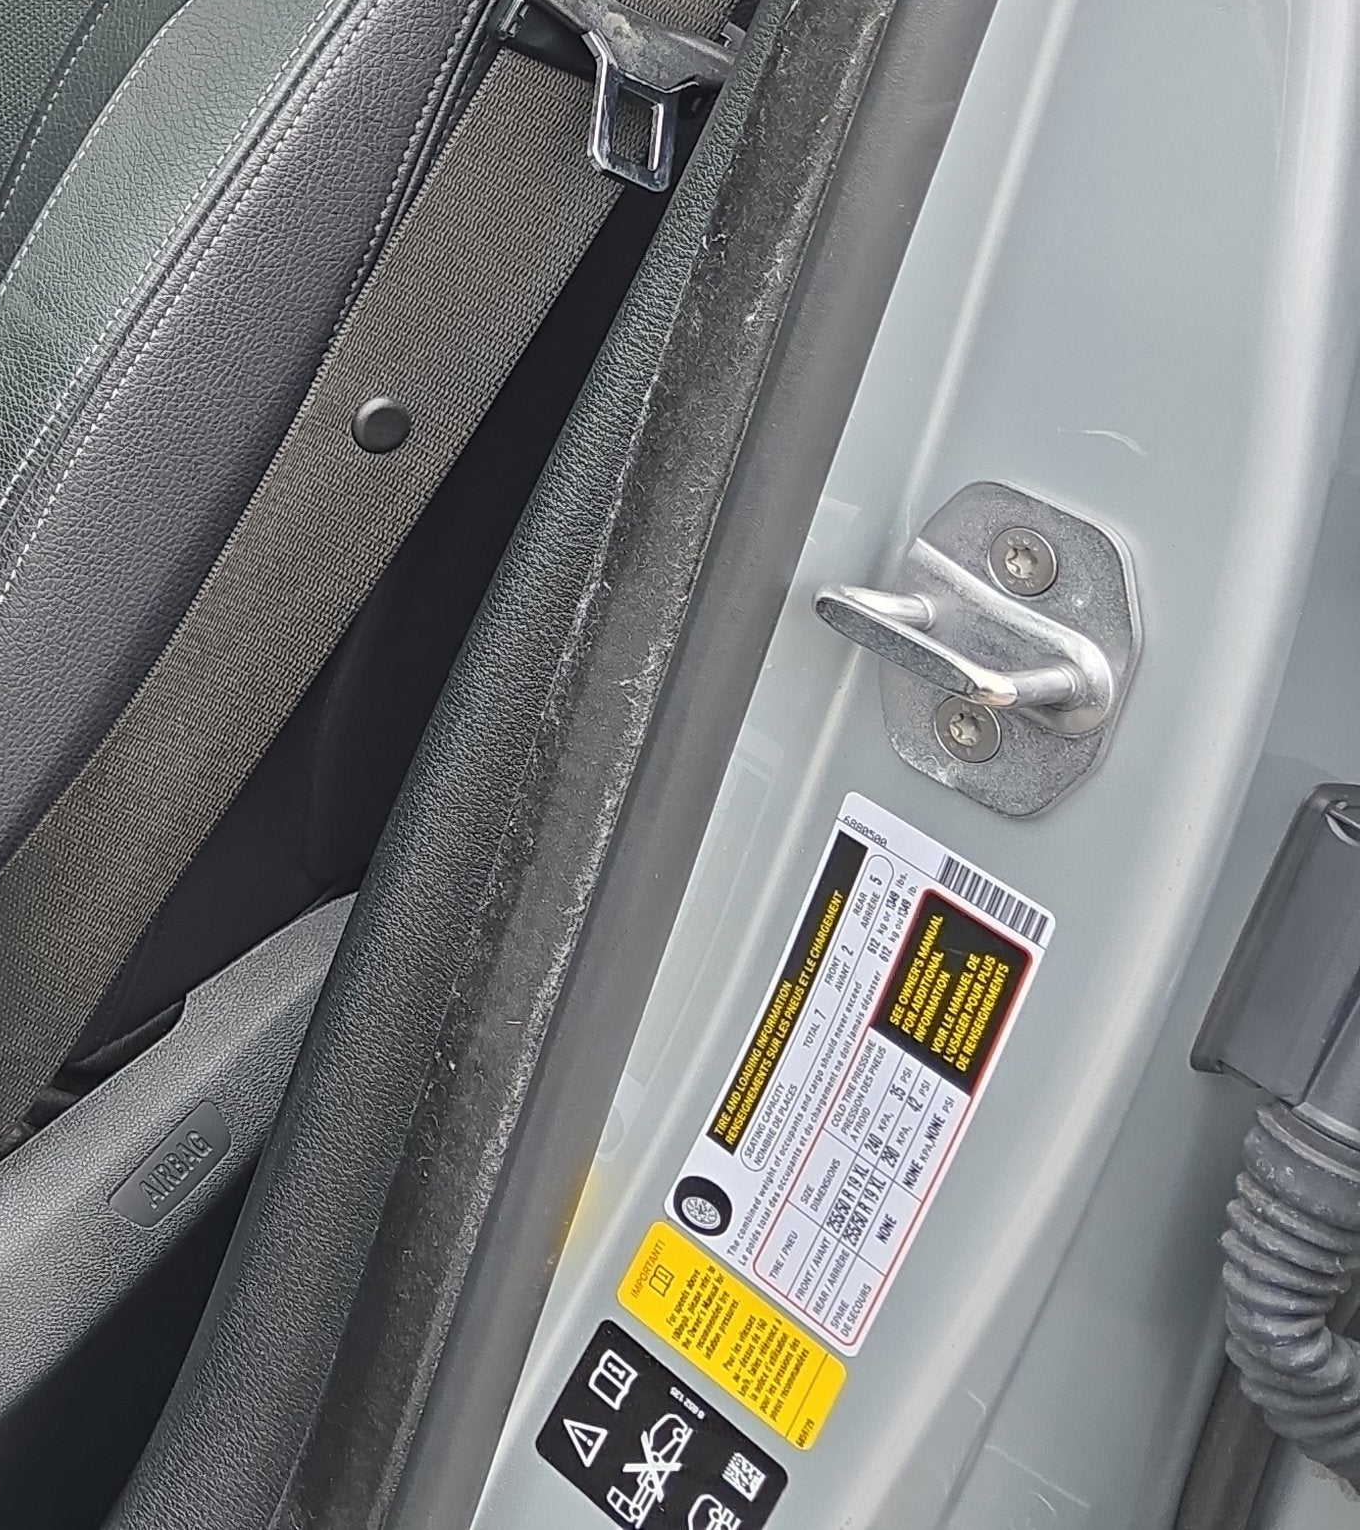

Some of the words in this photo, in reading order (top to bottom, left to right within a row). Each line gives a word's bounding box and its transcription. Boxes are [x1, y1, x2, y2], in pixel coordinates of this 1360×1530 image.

[852, 891, 868, 915] REAR
[869, 873, 882, 886] 5
[894, 869, 908, 888] lbs.
[906, 882, 918, 897] lb.
[858, 889, 880, 929] ARRIÈRE
[884, 889, 900, 911] 1349
[896, 897, 912, 919] 1349
[808, 889, 843, 960] CHARGEMENT
[875, 921, 888, 936] kg
[882, 910, 892, 922] or
[894, 917, 904, 930] ou
[866, 937, 880, 955] 612
[886, 929, 899, 943] kg
[803, 956, 816, 973] LE
[824, 955, 841, 985] FRONT
[840, 943, 854, 956] 2
[877, 944, 893, 963] 612
[888, 1002, 905, 1026] SEE
[897, 956, 924, 1006] OWNER'S
[916, 911, 943, 959] MANUAL
[965, 952, 981, 971] DE
[798, 970, 811, 987] ET
[834, 961, 851, 992] AVANT
[859, 969, 884, 1012] dépasser
[900, 1009, 918, 1034] FOR
[910, 947, 944, 1012] ADDITIONAL
[947, 968, 973, 1016] MANUEL
[784, 984, 805, 1020] PNEUS
[842, 980, 862, 1013] exceed
[912, 969, 951, 1043] INFORMATION
[942, 1011, 972, 1063] L'USAGER
[963, 981, 984, 1014] POUR
[976, 953, 996, 984] PLUS
[961, 961, 1009, 1056] RENSEIGNEMENTS
[775, 1017, 790, 1038] LES
[802, 1020, 820, 1049] TOTAL
[813, 1007, 827, 1020] 7
[832, 1012, 848, 1039] never
[846, 1009, 866, 1042] jamais
[941, 1012, 955, 1029] LE
[765, 1036, 781, 1060] SUR
[818, 1037, 837, 1069] should
[838, 1039, 852, 1060] doit
[930, 1025, 949, 1055] VOIR
[714, 1110, 731, 1137] TIRE
[725, 1089, 741, 1114] AND
[735, 1046, 762, 1092] LOADING
[755, 979, 792, 1050] INFORMATION
[833, 1058, 844, 1072] ne
[955, 1053, 970, 1072] DE
[808, 1068, 825, 1096] cargo
[809, 1070, 839, 1124] chargement
[830, 1102, 847, 1128] COLD
[841, 1081, 856, 1104] TIRE
[850, 1038, 876, 1084] PRESSURE
[840, 1091, 865, 1136] PRESSION
[859, 1073, 873, 1094] DES
[867, 1044, 887, 1076] PNEUS
[725, 1057, 772, 1145] RENSEIGNEMENTS
[798, 1092, 812, 1112] and
[863, 1131, 883, 1156] 240
[888, 1082, 906, 1102] 35
[899, 1066, 912, 1084] PSI
[744, 1122, 766, 1159] SEATING
[761, 1081, 785, 1124] CAPACITY
[753, 1127, 776, 1166] NOMBRE
[771, 1114, 782, 1129] DE
[777, 1082, 798, 1116] PLACES
[778, 1110, 805, 1158] occupants
[802, 1121, 814, 1136] du
[852, 1105, 871, 1135] FROID
[880, 1144, 900, 1168] 290
[905, 1094, 923, 1114] 42
[917, 1079, 931, 1097] PSI
[797, 1135, 807, 1147] et
[901, 1159, 923, 1190] NONE
[941, 1095, 955, 1114] PSI
[139, 1131, 213, 1209] AIRBAG
[771, 1154, 782, 1168] of
[776, 1146, 803, 1192] occupants
[851, 1160, 869, 1180] XL
[756, 1165, 777, 1199] weight
[799, 1182, 815, 1205] SIZE
[809, 1156, 841, 1212] DIMENSIONS
[841, 1187, 856, 1202] R
[845, 1174, 862, 1192] 19
[862, 1187, 879, 1206] 19
[868, 1173, 886, 1193] XL
[766, 1189, 780, 1209] des
[857, 1200, 873, 1215] R
[735, 1195, 761, 1241] combined
[756, 1206, 772, 1230] total
[825, 1196, 851, 1234] 255/50
[842, 1209, 868, 1247] 255/50
[875, 1212, 897, 1244] NONE
[726, 1237, 740, 1257] The
[744, 1227, 761, 1255] poids
[768, 1258, 783, 1280] TIRE
[781, 1229, 798, 1256] PNEU
[629, 1238, 666, 1298] IMPORTANT!
[738, 1252, 749, 1266] Le
[794, 1267, 815, 1302] FRONT
[812, 1235, 831, 1268] AVANT
[812, 1289, 829, 1316] REAR
[825, 1246, 850, 1287] ARRIÈRE
[830, 1299, 849, 1330] SPARE
[840, 1320, 853, 1337] DE
[847, 1282, 872, 1325] SECOURS
